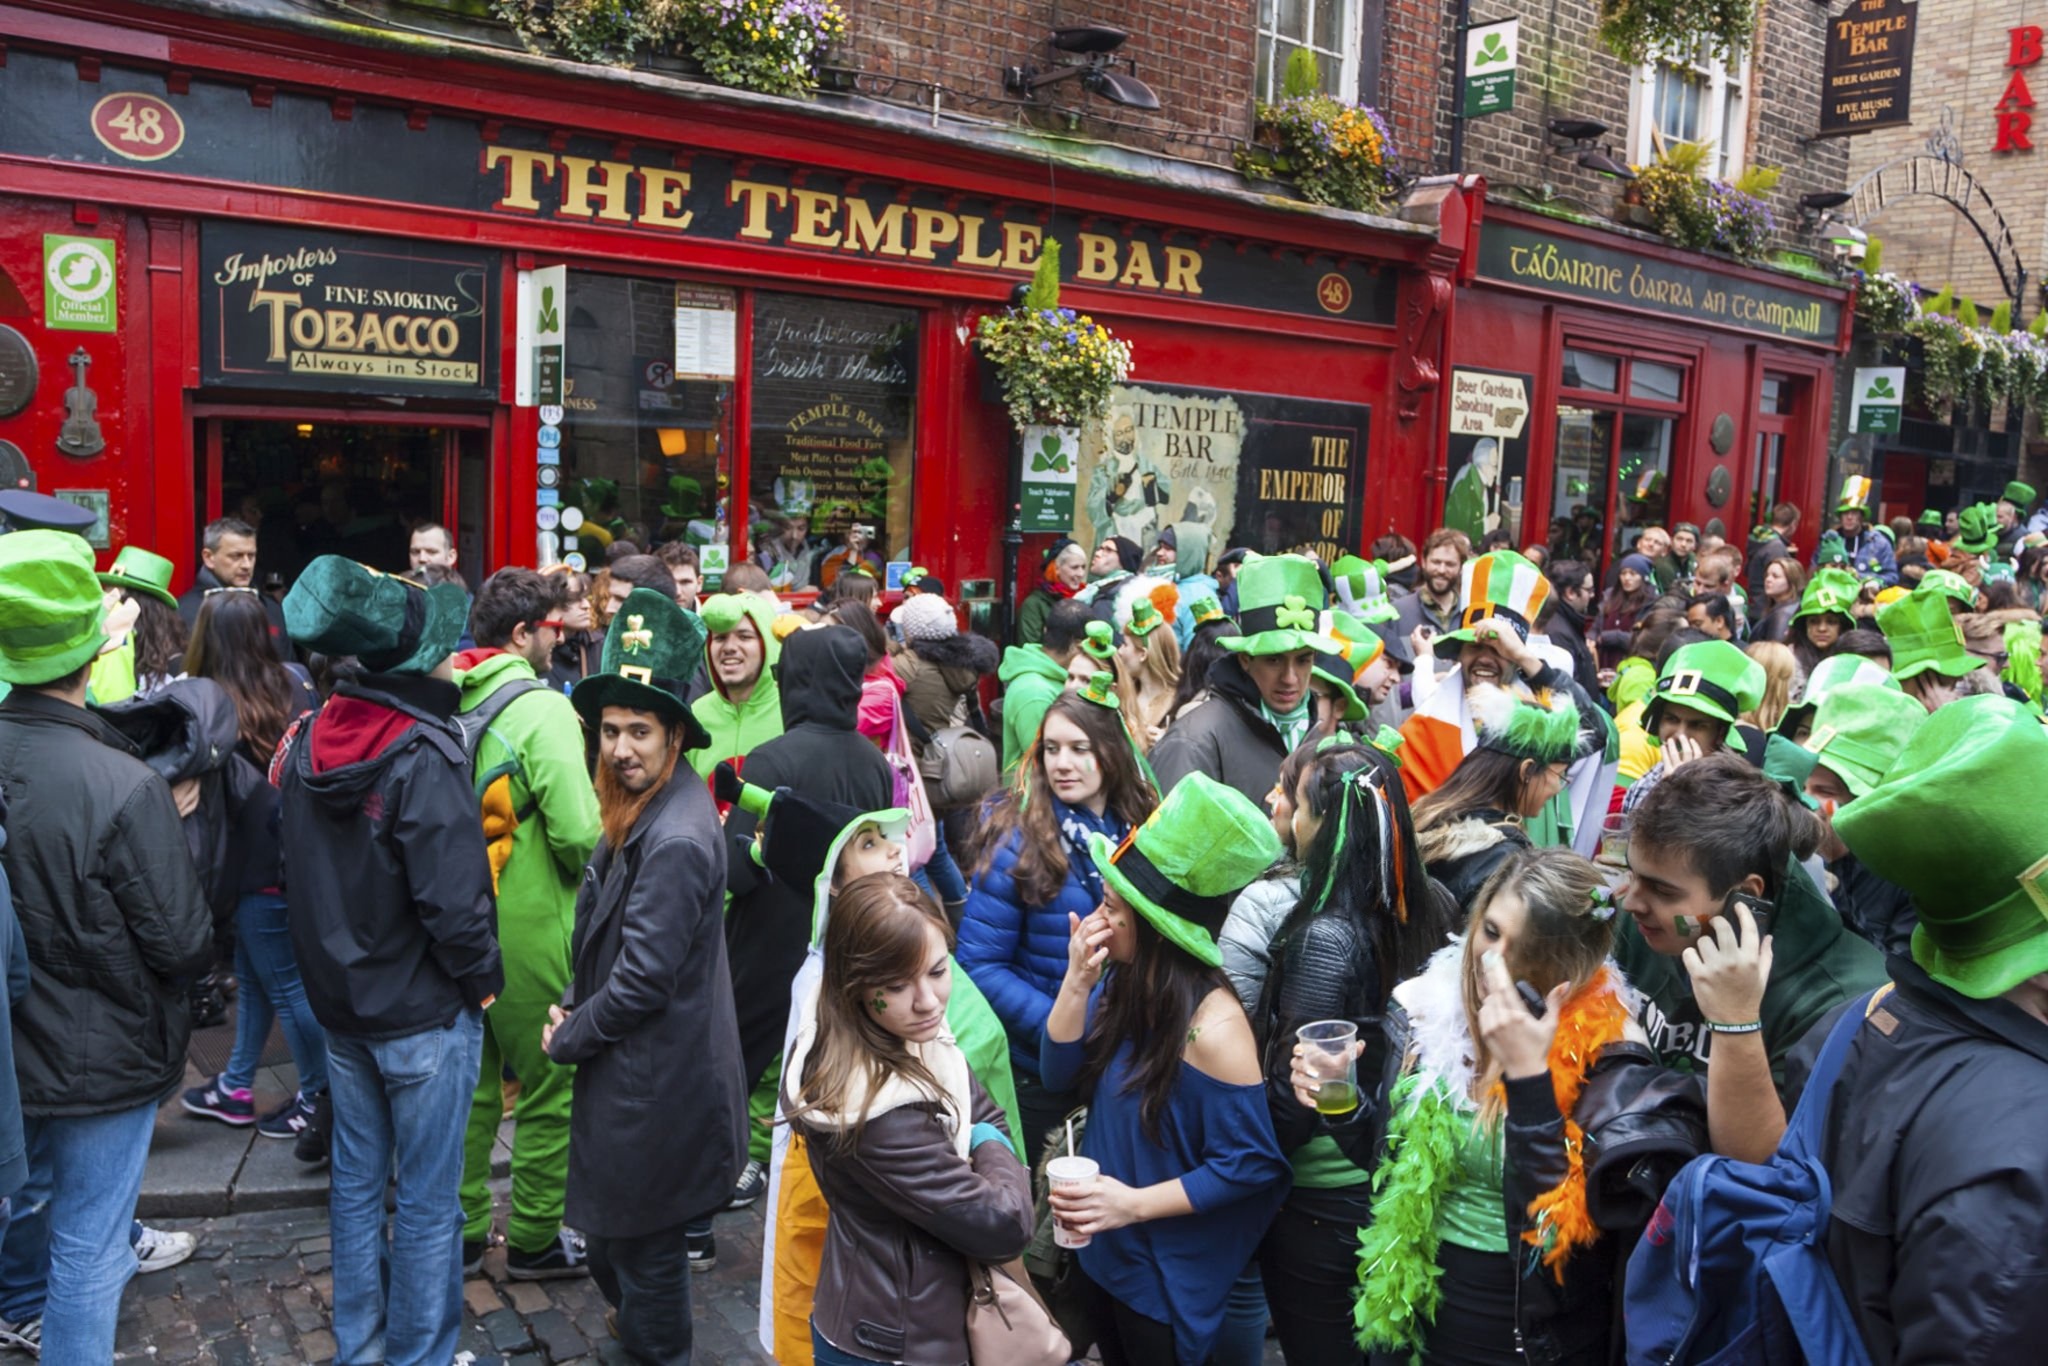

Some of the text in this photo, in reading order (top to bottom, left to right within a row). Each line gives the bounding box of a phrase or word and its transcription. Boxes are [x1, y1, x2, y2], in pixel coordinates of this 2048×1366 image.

[1861, 0, 1885, 11] THE
[1836, 16, 1907, 40] TEMPLE
[1850, 36, 1888, 56] BAR
[1832, 67, 1901, 86] BEER GARDEN
[1991, 25, 2044, 152] BAR
[1836, 97, 1893, 114] LIVE MUSIC
[1849, 109, 1877, 122] DAILY
[108, 102, 164, 145] 48
[485, 145, 1203, 295] THE TEMPLE BAR
[214, 246, 338, 290] Importers
[292, 273, 315, 286] OF
[324, 285, 459, 313] FINE SMOKING
[1321, 280, 1344, 305] 48
[58, 310, 106, 322] Member
[61, 300, 102, 312] Official
[295, 352, 475, 380] Always in Stock
[763, 347, 908, 384] Irish Music
[1456, 376, 1477, 394] Beer
[1481, 379, 1514, 399] Garden
[1133, 402, 1239, 433] TEMPLE
[1455, 395, 1493, 417] Smoking
[787, 403, 885, 437] TEMPLE BAR
[1461, 415, 1483, 431] Area
[785, 434, 836, 447] Traditional
[840, 437, 861, 448] Food
[1165, 432, 1214, 463] BAR
[1311, 435, 1349, 468] THE
[1260, 468, 1346, 504] EMPEROR
[1322, 508, 1344, 538] OF
